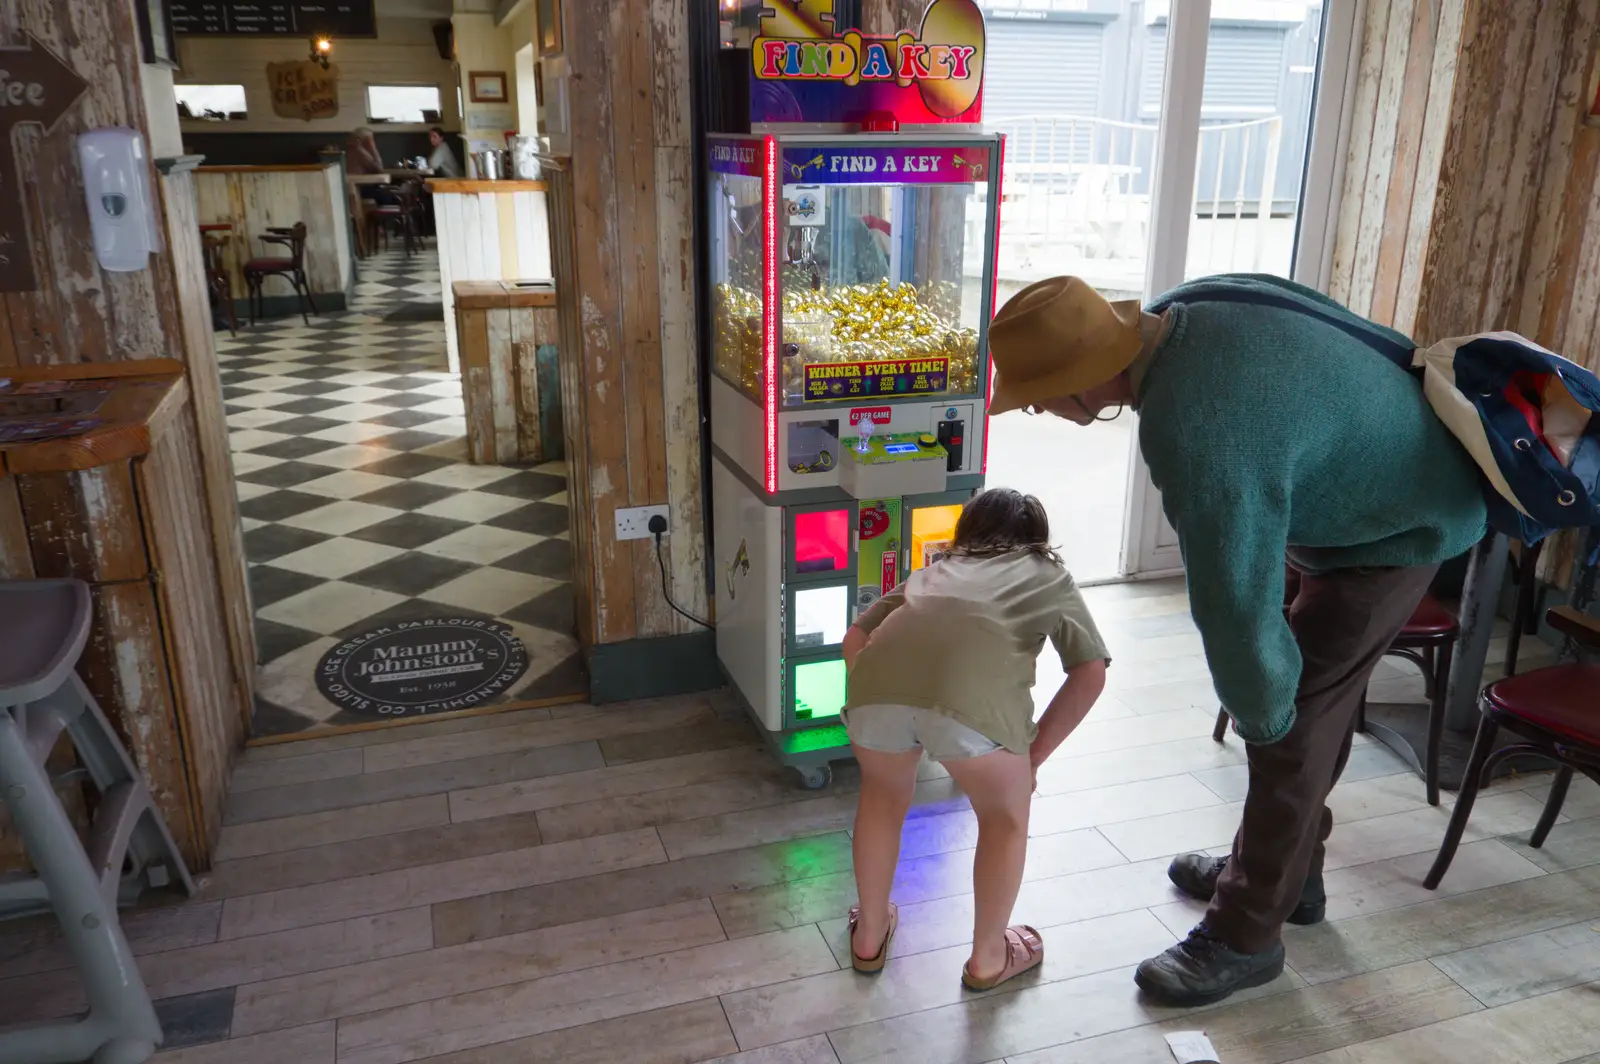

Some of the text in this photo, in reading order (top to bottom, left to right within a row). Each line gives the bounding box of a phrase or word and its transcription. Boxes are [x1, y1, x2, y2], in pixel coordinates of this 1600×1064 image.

[761, 41, 976, 79] FIND A KEY
[714, 145, 755, 164] FIND A KEY
[829, 155, 942, 173] FIND A KEY
[808, 361, 945, 379] WINNER EVERY TIME!
[851, 412, 859, 420] €2
[873, 411, 890, 419] GAME
[324, 657, 341, 675] ICE
[336, 627, 392, 656] CREAM
[398, 618, 486, 630] PARLOUR
[372, 638, 481, 661] Mammy
[353, 648, 499, 677] Johnston's
[328, 683, 370, 710] SLIGO
[399, 686, 423, 694] Est.
[415, 661, 523, 714] STRANDHILL
